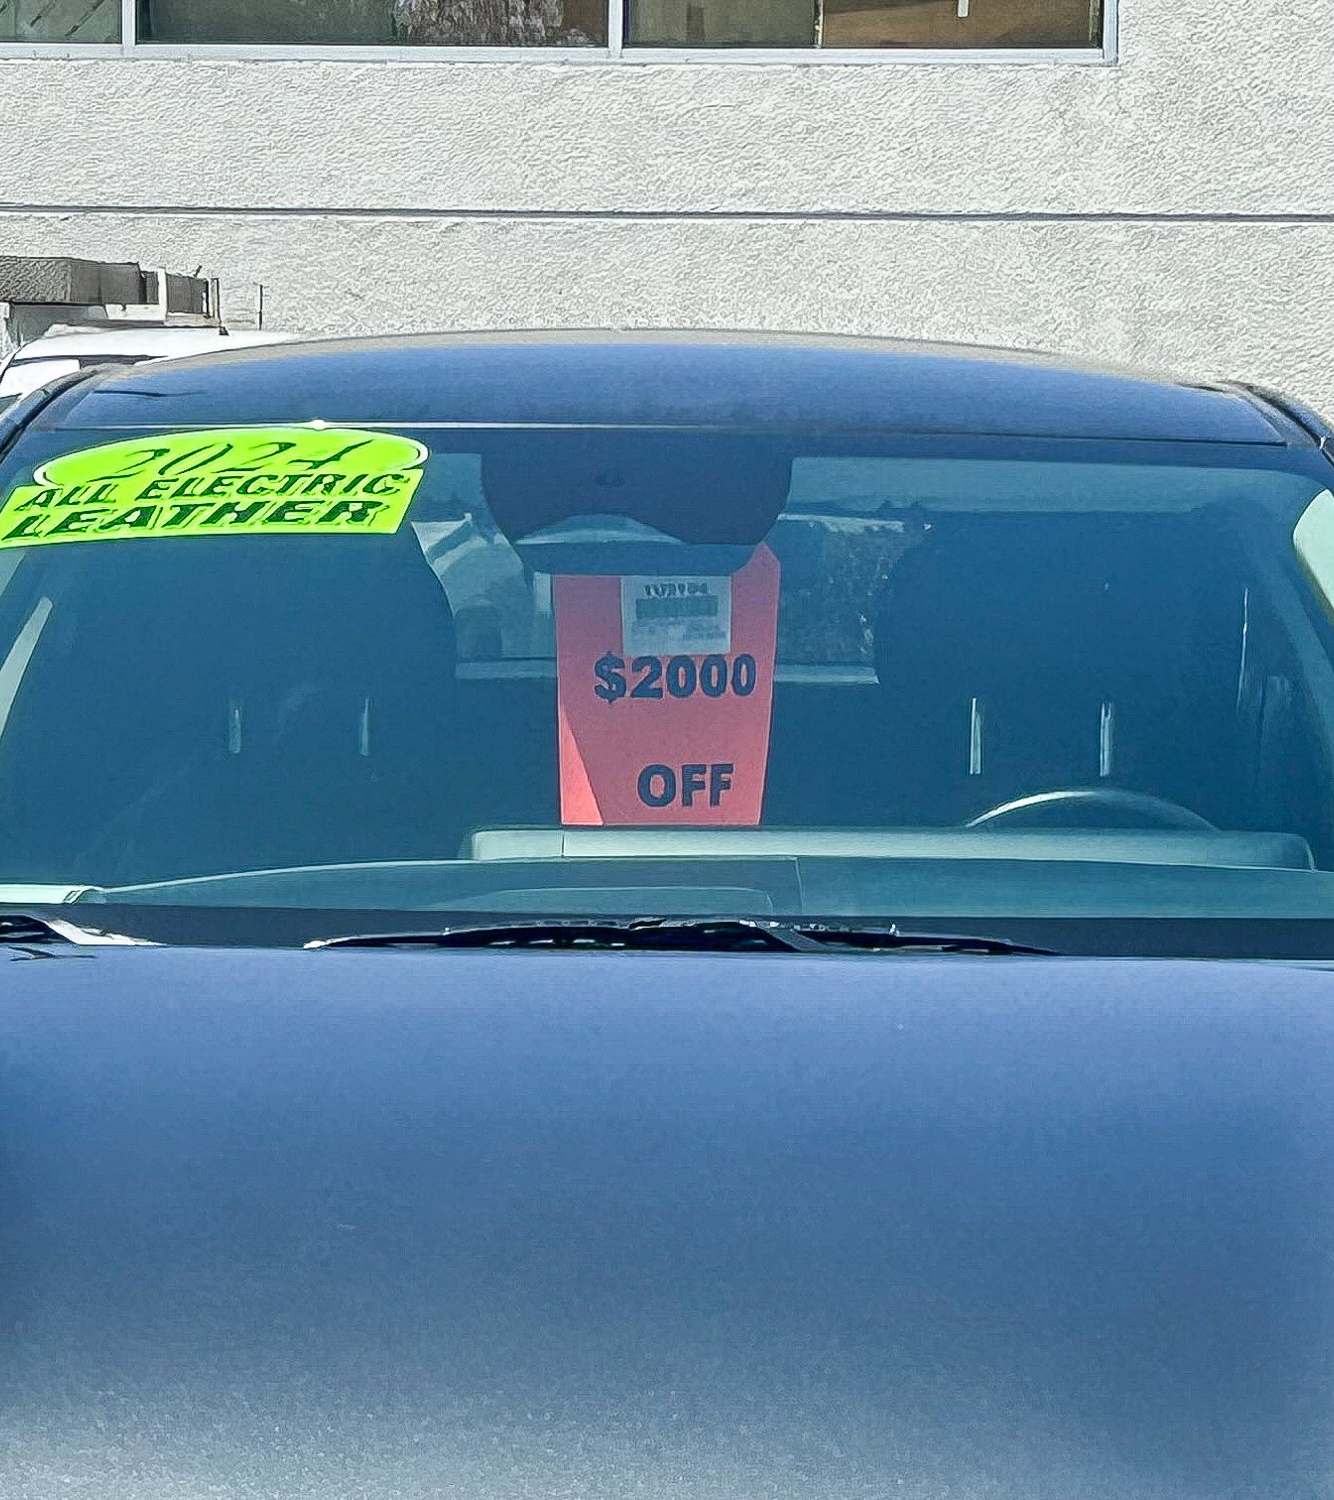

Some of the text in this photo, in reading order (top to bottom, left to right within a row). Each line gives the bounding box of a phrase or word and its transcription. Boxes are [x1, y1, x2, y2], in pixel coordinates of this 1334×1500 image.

[87, 438, 376, 482] 2024
[14, 473, 406, 511] ALL ELECTRIC
[1, 500, 391, 542] LEATHER
[594, 651, 756, 704] $2000
[637, 763, 734, 807] OFF
